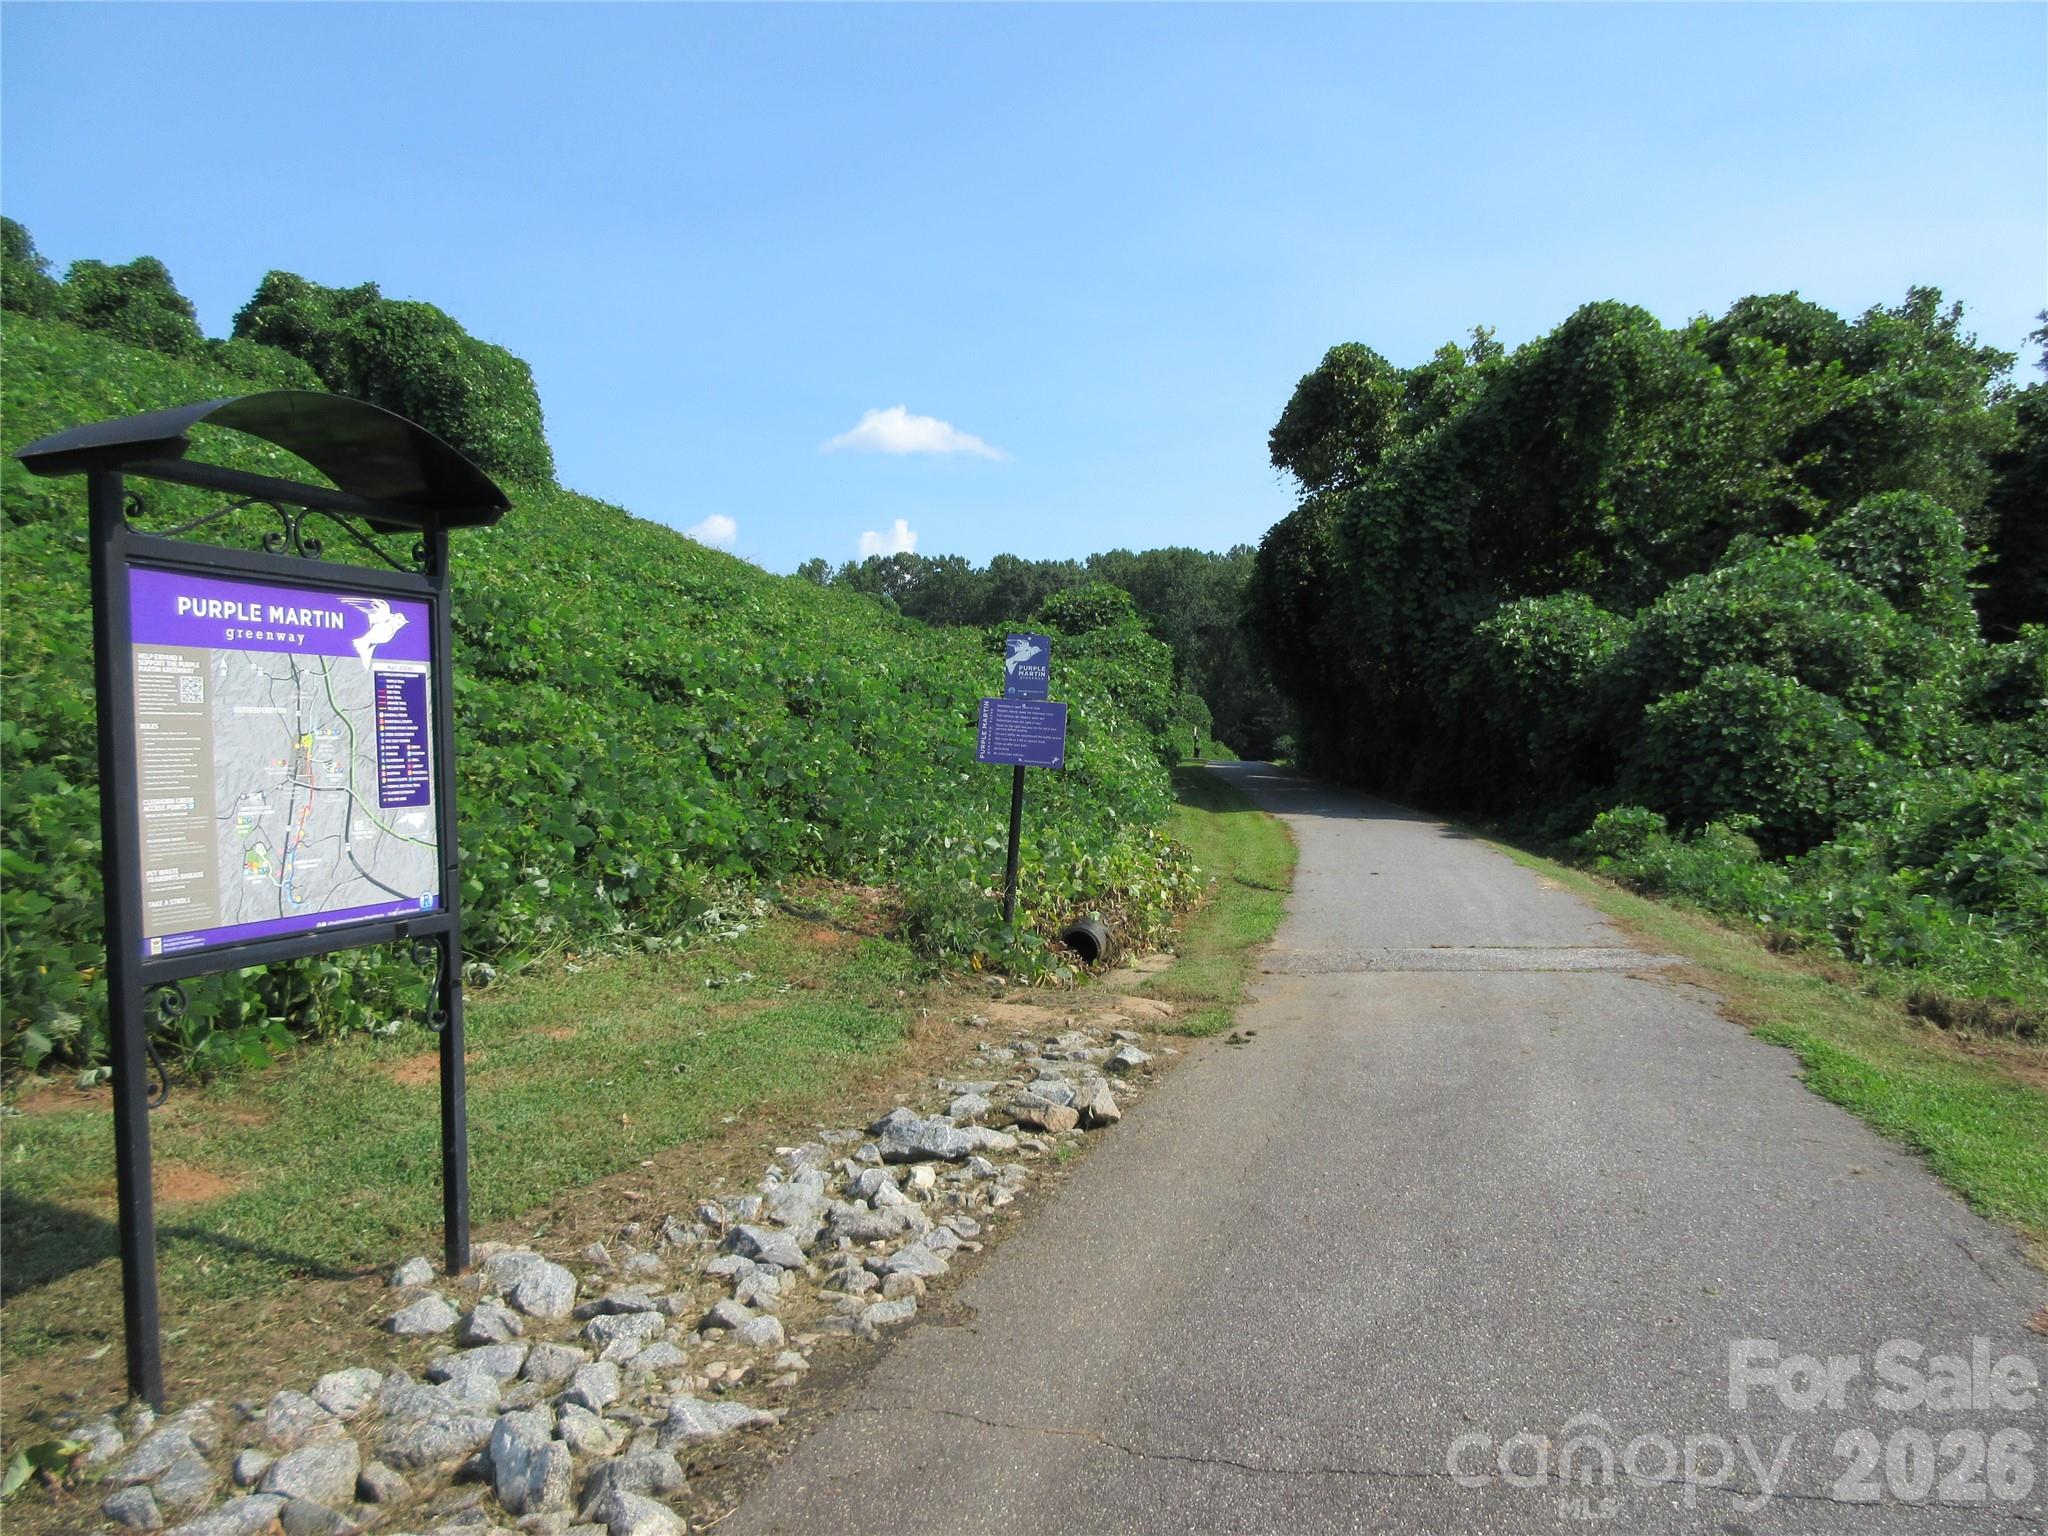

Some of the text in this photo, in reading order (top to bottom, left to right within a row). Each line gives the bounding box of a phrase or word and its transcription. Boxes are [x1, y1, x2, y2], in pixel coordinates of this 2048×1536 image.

[177, 596, 344, 629] PURPLE MARTIN
[226, 628, 305, 645] greenway
[982, 701, 990, 729] MARTIN
